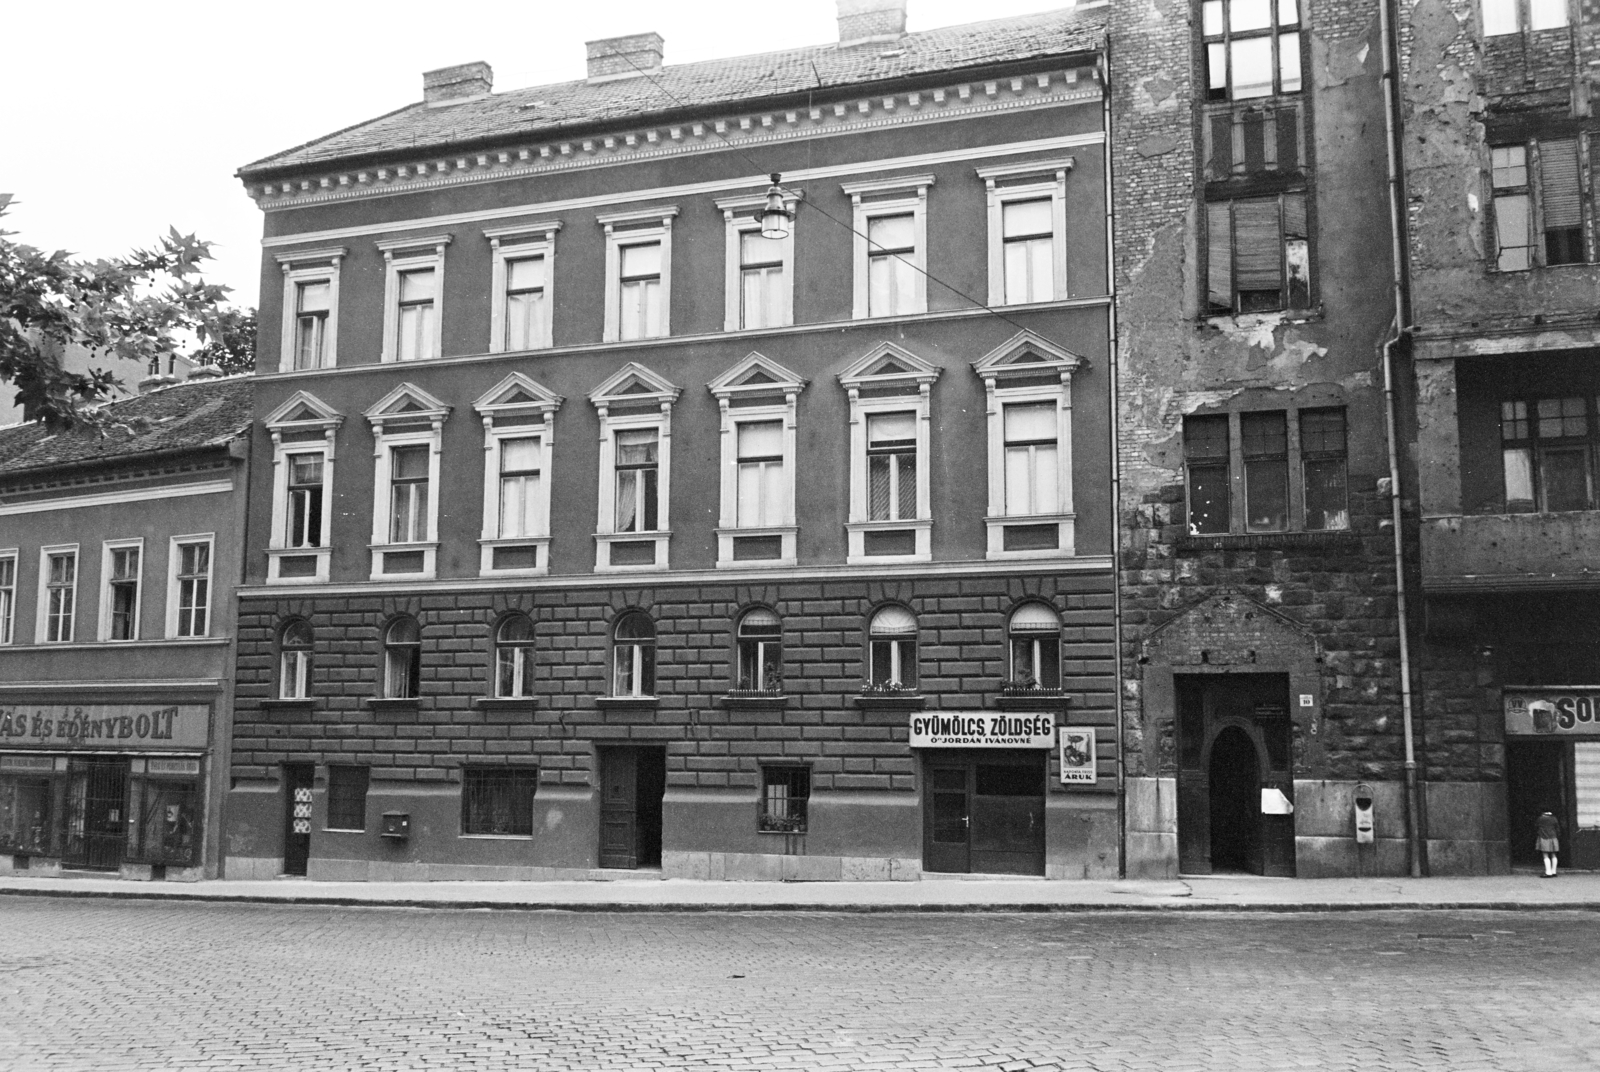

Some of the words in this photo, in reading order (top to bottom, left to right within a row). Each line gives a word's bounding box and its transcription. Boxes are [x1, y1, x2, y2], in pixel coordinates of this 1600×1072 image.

[31, 710, 53, 737] ÉS
[914, 715, 987, 738] GYÜMÖLCS,
[991, 715, 1050, 736] ZÖLDSÉG
[985, 736, 1031, 744] IVÁNOVNÉ
